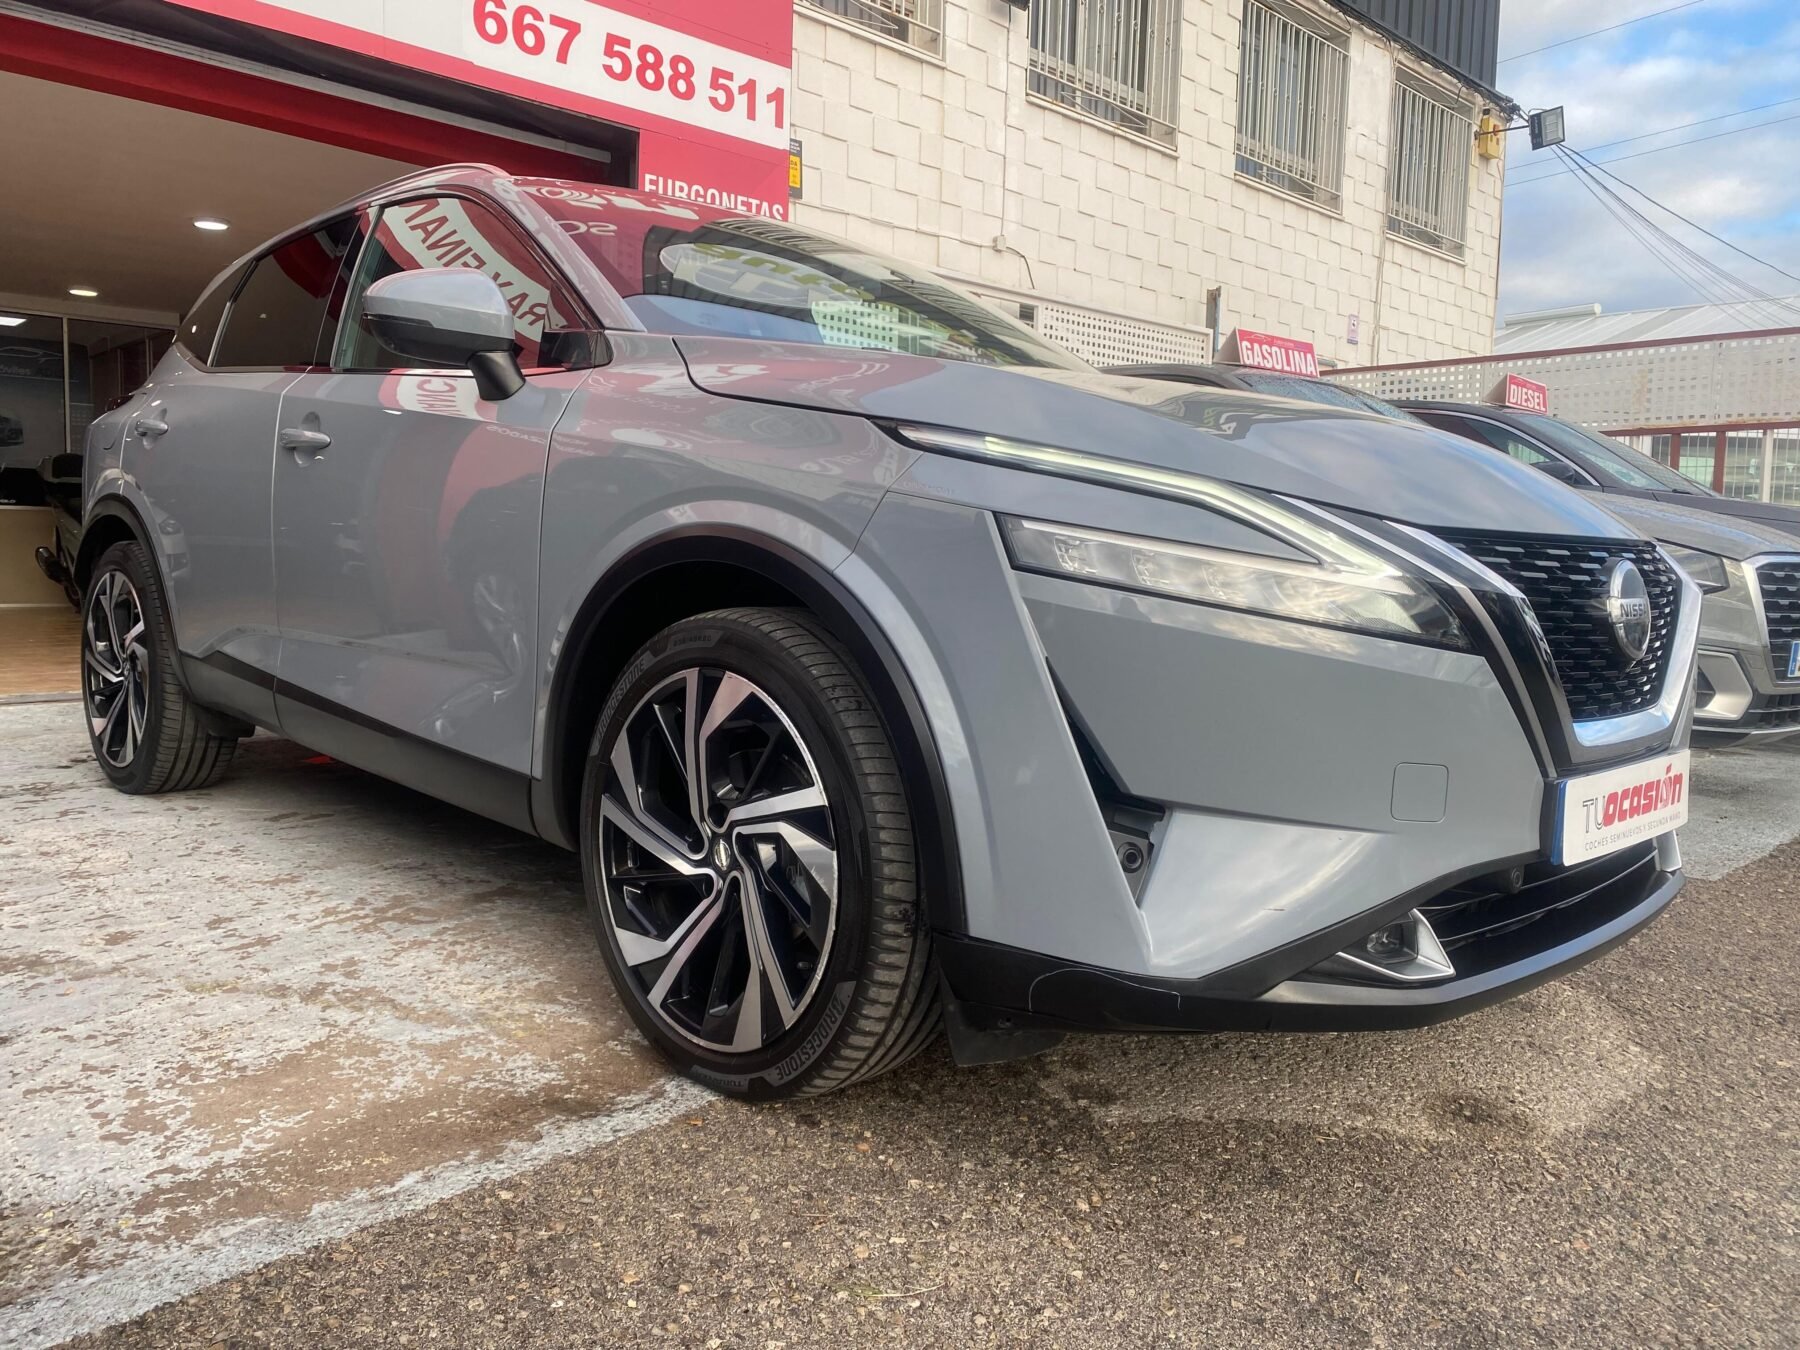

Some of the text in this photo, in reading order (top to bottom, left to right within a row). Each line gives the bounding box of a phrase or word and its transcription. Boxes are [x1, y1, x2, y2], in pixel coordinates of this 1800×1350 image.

[473, 0, 785, 129] 667 588 511
[1241, 340, 1316, 376] GASOLINA
[1509, 383, 1546, 411] DIESEL
[1585, 836, 1608, 852] COCHES
[774, 992, 845, 1080] BRIDGESTONE
